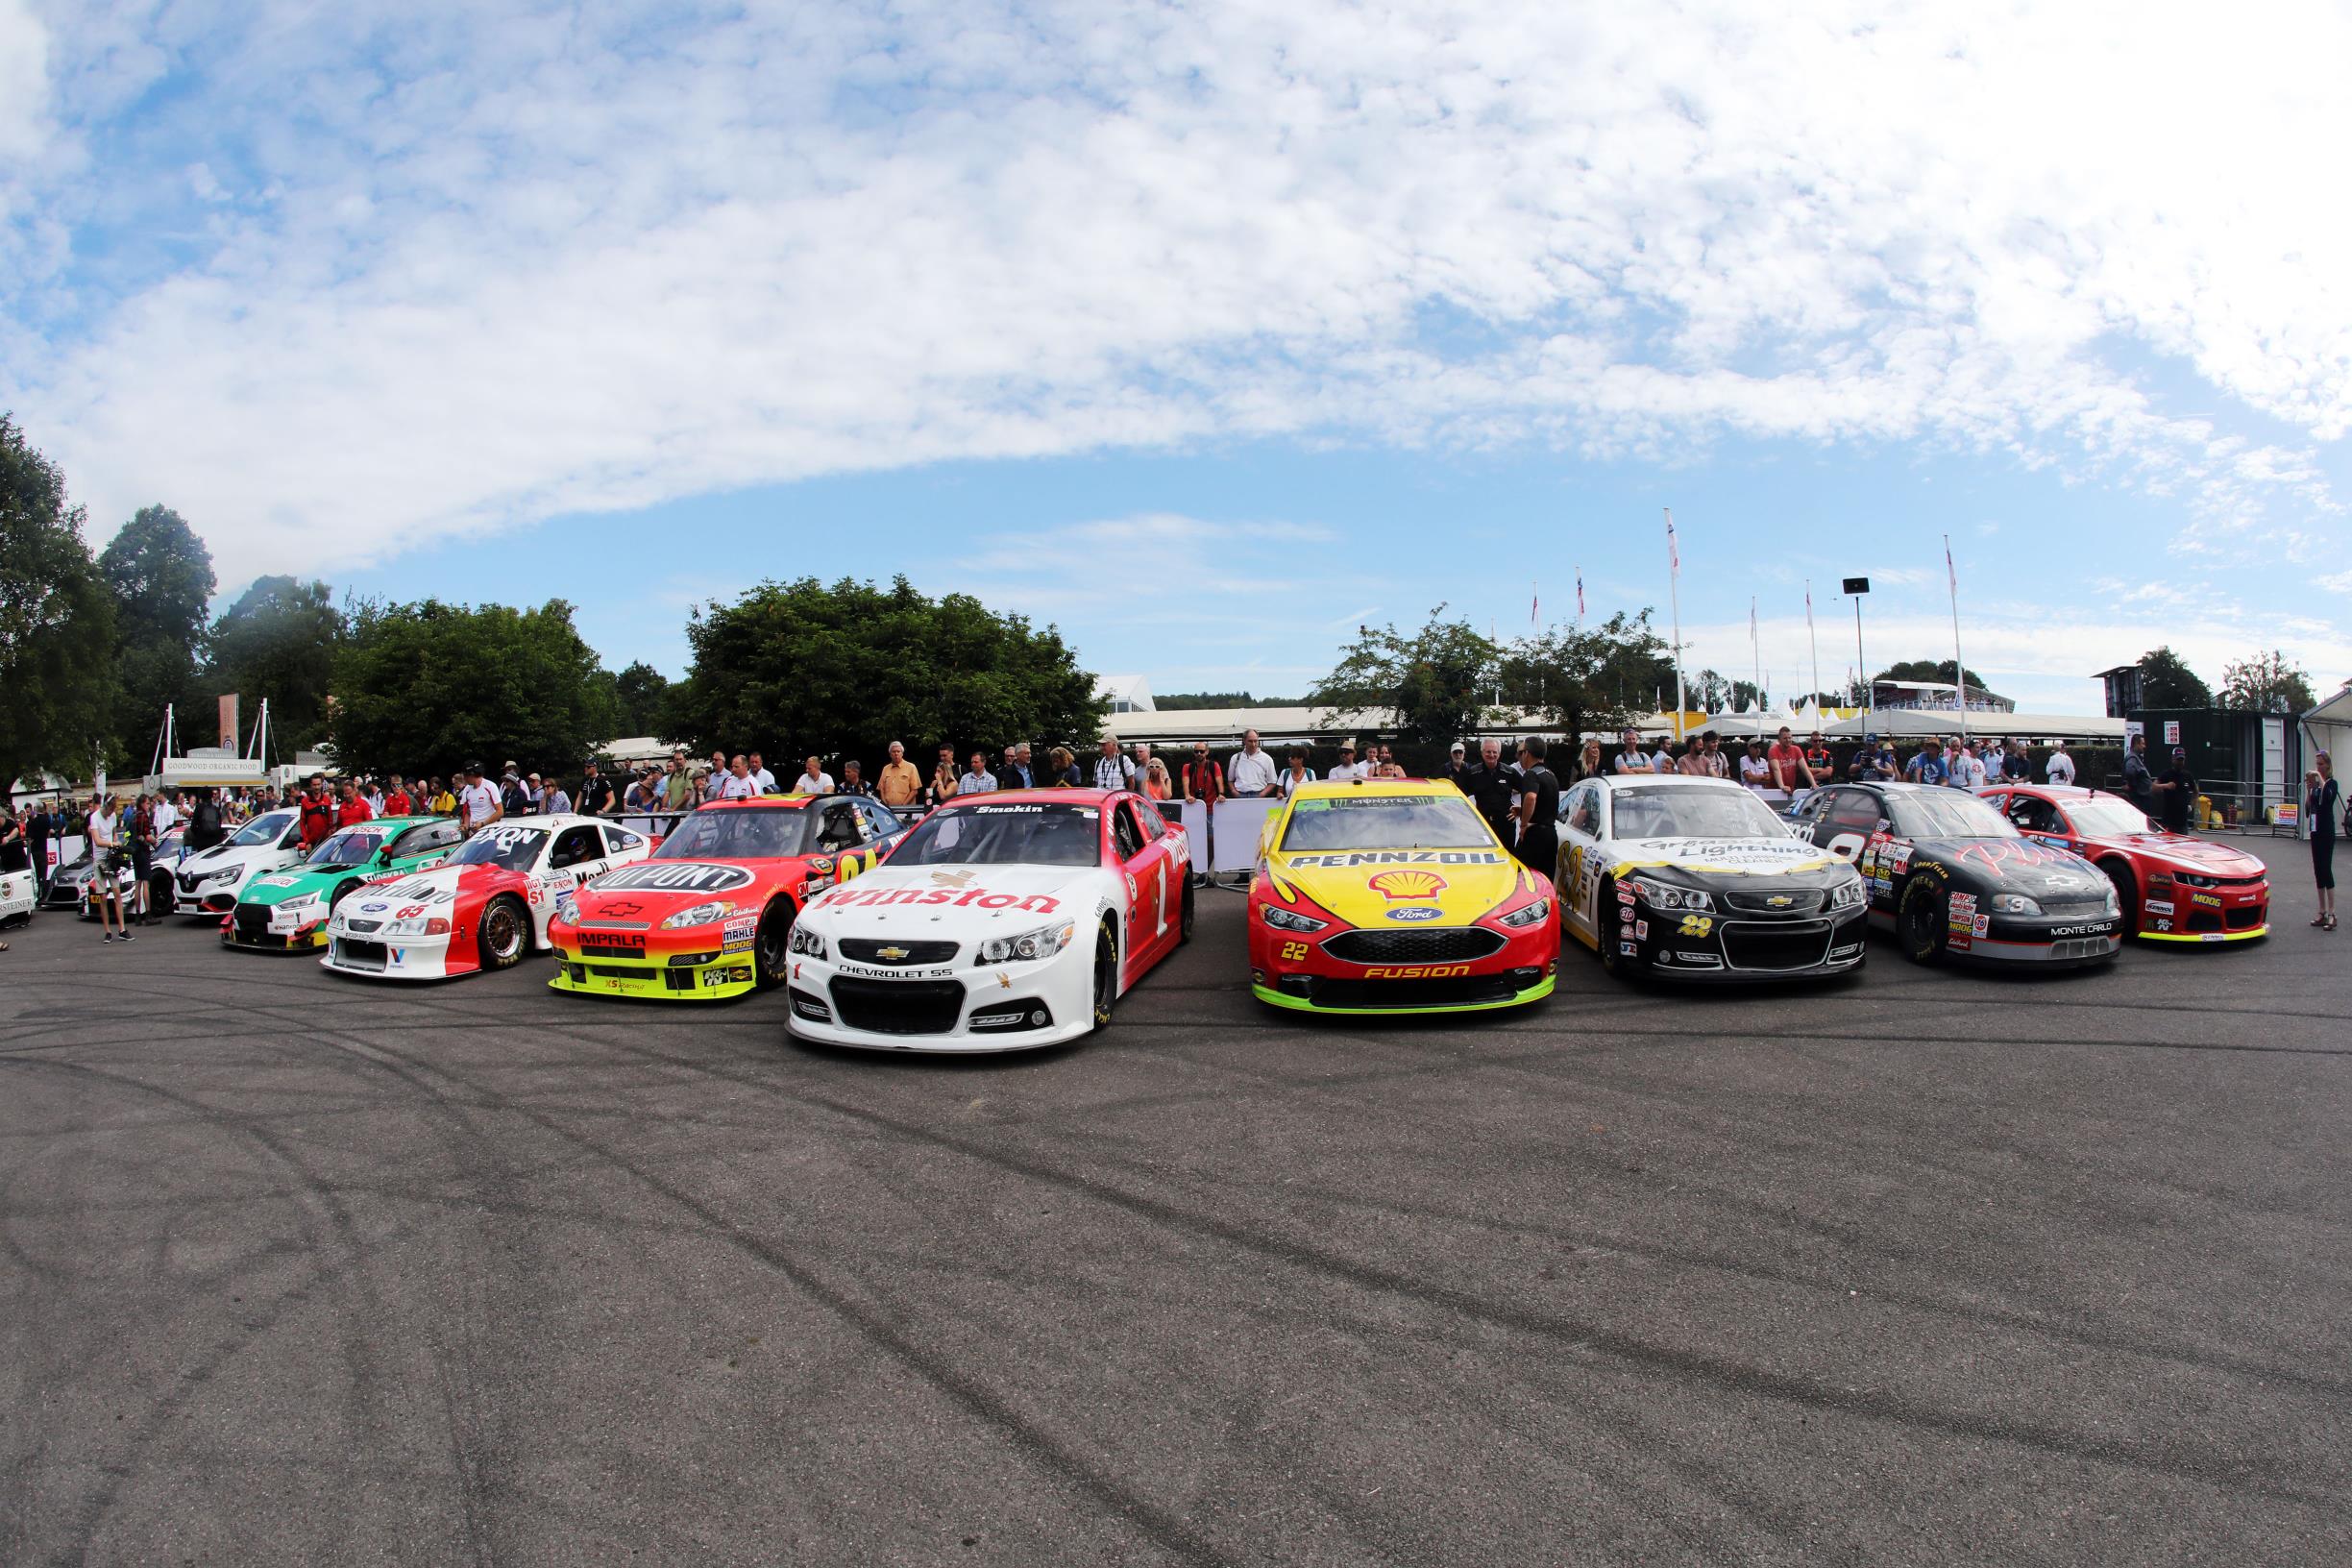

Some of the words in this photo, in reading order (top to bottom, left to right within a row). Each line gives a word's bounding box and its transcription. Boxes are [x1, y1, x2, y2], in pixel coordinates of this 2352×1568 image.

[1678, 845, 1819, 858] Lightning
[1288, 851, 1508, 869] PENNZOIL
[1894, 860, 1907, 873] 3M
[1914, 861, 1948, 879] GOODYEAR
[798, 882, 808, 898] 3M
[1949, 892, 1970, 901] COMP
[1157, 858, 1167, 938] 1
[2010, 897, 2024, 912] 3
[2192, 893, 2222, 907] MOOG
[396, 904, 429, 919] 65
[733, 907, 760, 917] Edelbrock
[1396, 907, 1433, 919] Ford
[1622, 909, 1633, 918] STP
[2146, 902, 2172, 913] KENNOL
[725, 919, 750, 928] COMP
[1950, 914, 1972, 924] SIMPSON
[1976, 919, 1985, 927] 76
[1948, 922, 1972, 933] MOOG
[2050, 927, 2086, 937] MONTE
[2087, 923, 2112, 933] CARLO
[577, 933, 647, 946] IMPALA
[723, 928, 754, 941] MAHLE
[723, 941, 753, 951] MOOG
[1281, 942, 1309, 961] 22
[794, 963, 801, 980] 1
[840, 965, 924, 978] CHEVROLET
[1364, 966, 1470, 978] FUSION
